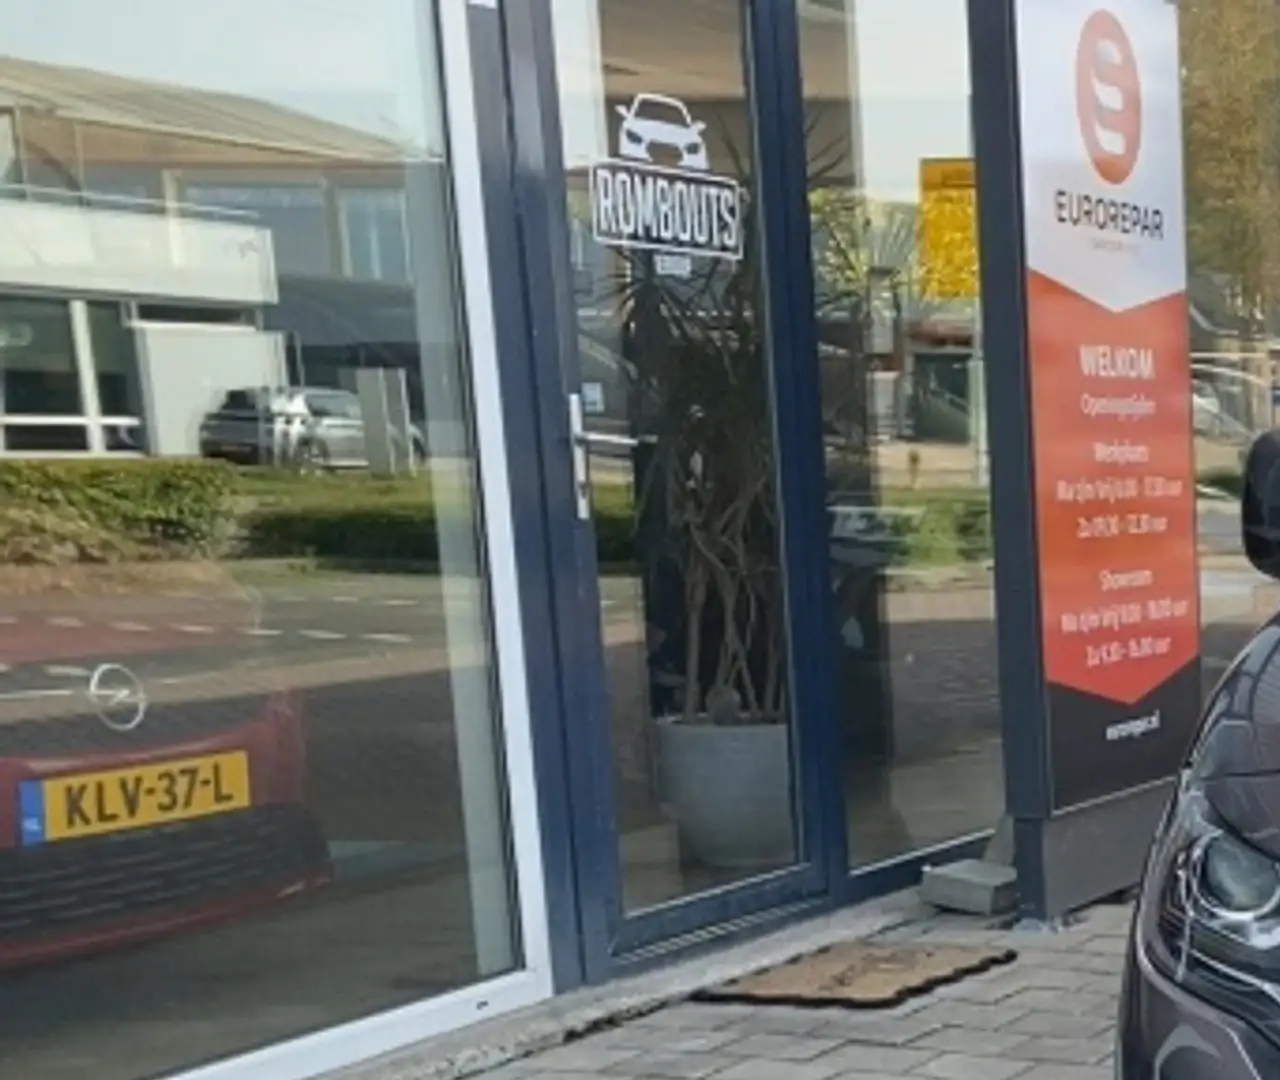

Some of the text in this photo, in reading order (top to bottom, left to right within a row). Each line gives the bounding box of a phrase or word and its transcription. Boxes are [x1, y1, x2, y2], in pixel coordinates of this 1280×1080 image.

[596, 168, 738, 249] ROMBOUTS
[1054, 189, 1164, 240] EUROREPAR
[1079, 344, 1155, 380] WELKOM
[65, 760, 234, 829] KLV-37-L
